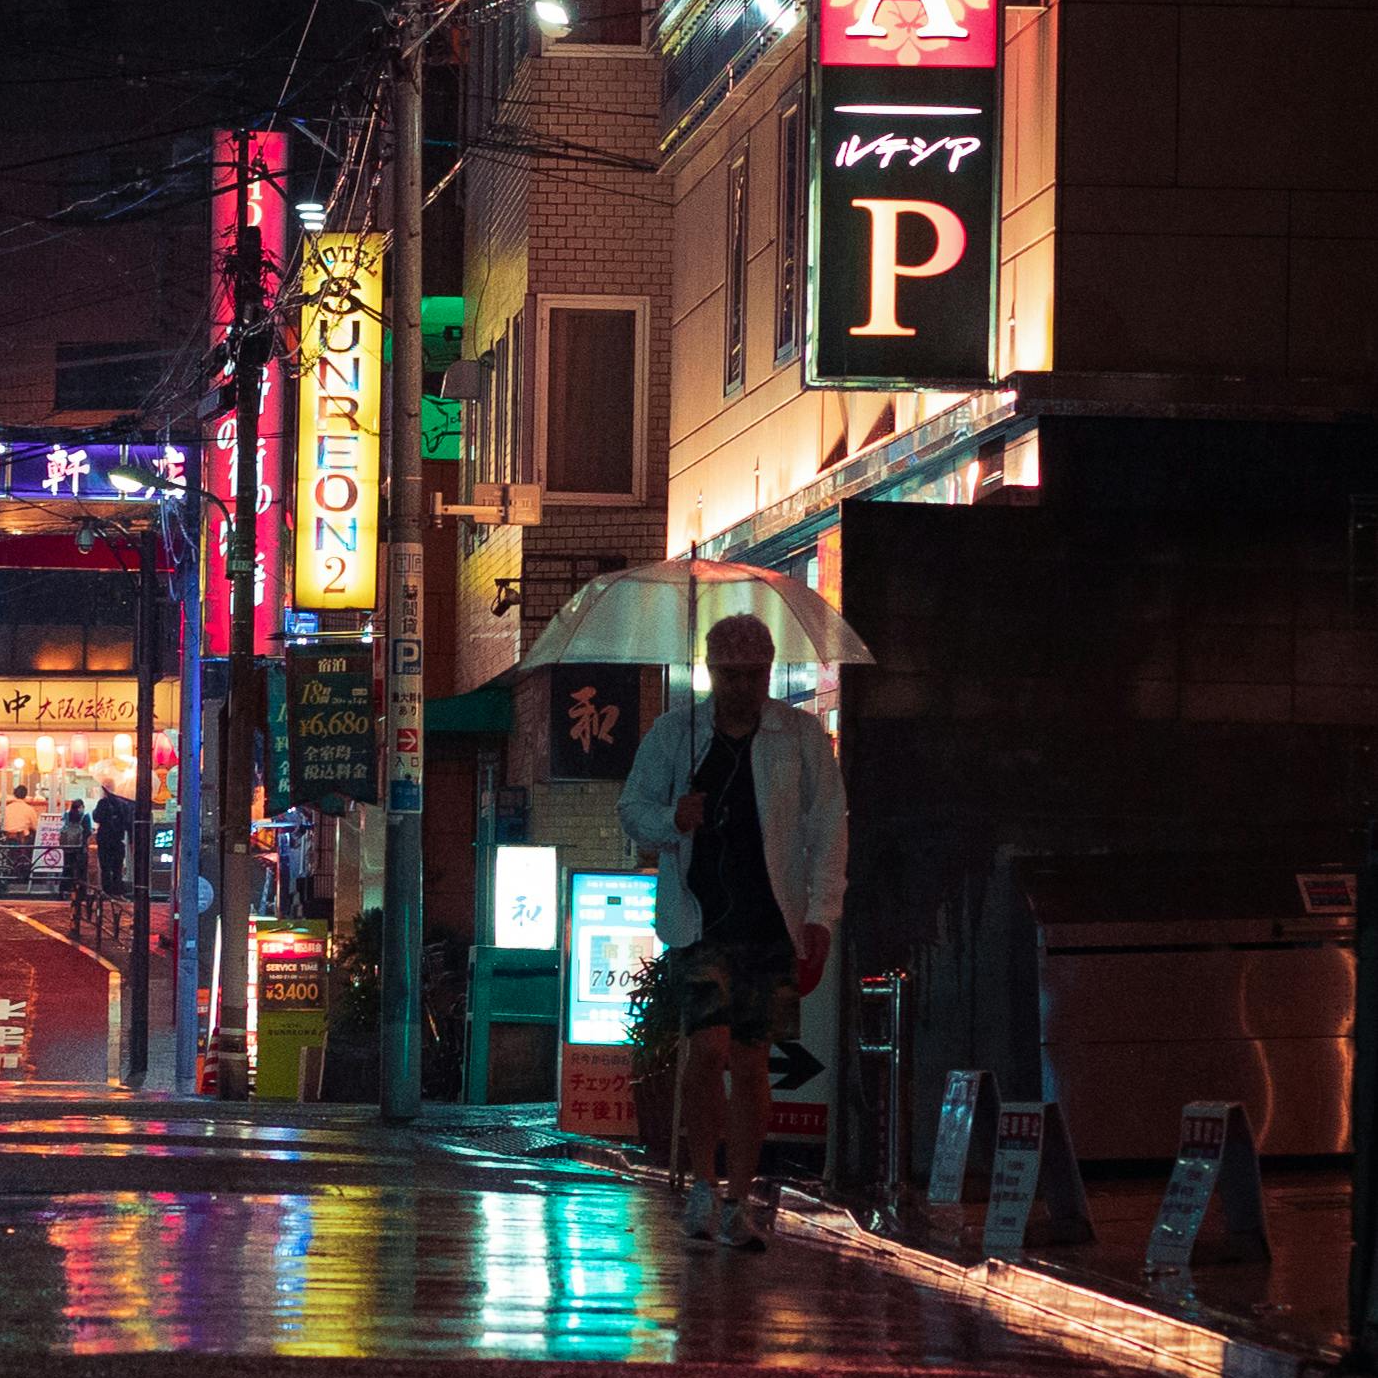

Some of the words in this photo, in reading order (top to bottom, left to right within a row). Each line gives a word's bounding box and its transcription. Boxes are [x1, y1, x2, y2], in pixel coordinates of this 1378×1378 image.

[835, 134, 982, 174] ルテシア
[849, 197, 968, 337] P
[314, 276, 363, 552] SUNREON
[322, 556, 347, 595] 2
[299, 710, 370, 738] ¥6,680
[567, 685, 621, 754] 和
[265, 963, 298, 973] SERVICE
[301, 963, 319, 973] TIME
[265, 982, 319, 1002] ¥3,400
